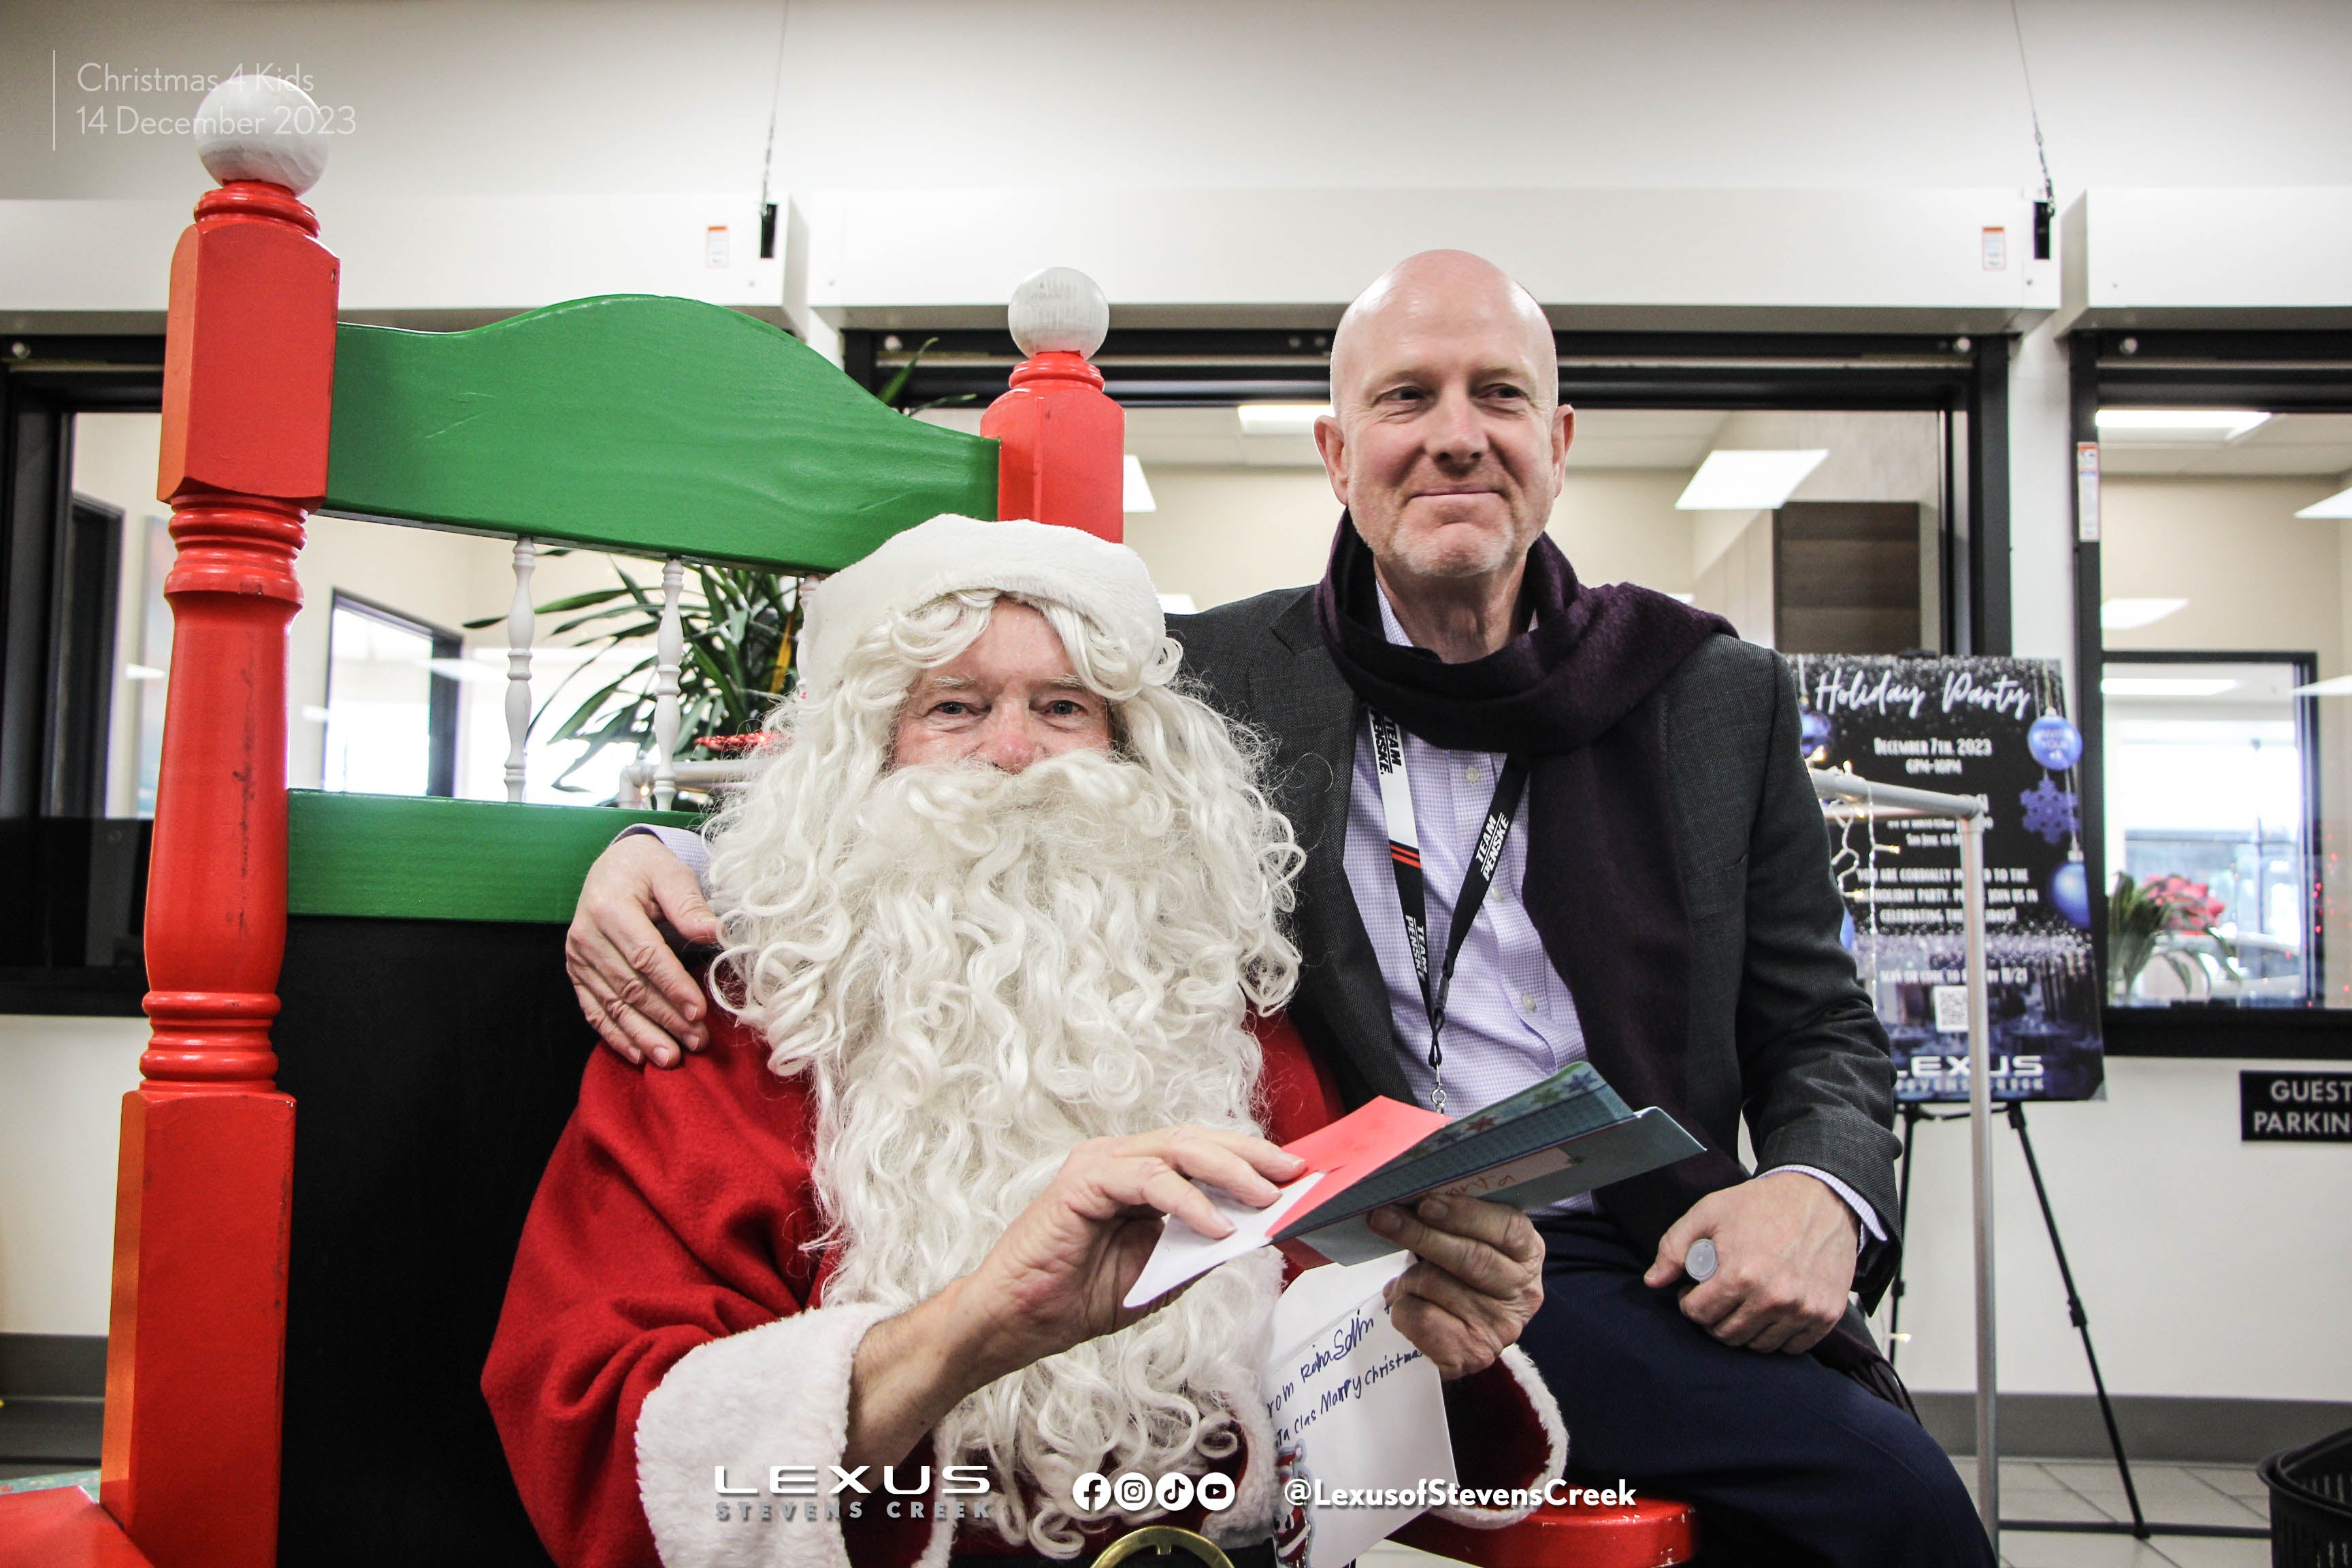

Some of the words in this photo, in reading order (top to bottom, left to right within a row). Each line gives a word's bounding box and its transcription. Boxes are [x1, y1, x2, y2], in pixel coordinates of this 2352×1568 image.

[1814, 667, 1926, 719] Holiday
[1942, 670, 2031, 721] Party
[1957, 737, 1993, 756] 2023
[1475, 814, 1497, 864] TEAM
[1482, 813, 1509, 882] PENSKE
[1405, 915, 1426, 982] PENSKE
[1416, 926, 1428, 974] TEAM
[1897, 1056, 2044, 1077] EXUS
[2270, 1079, 2352, 1102] GUEST
[2253, 1111, 2352, 1133] PARKIN
[1365, 1349, 1424, 1386] Christma
[1267, 1382, 1294, 1419] rom
